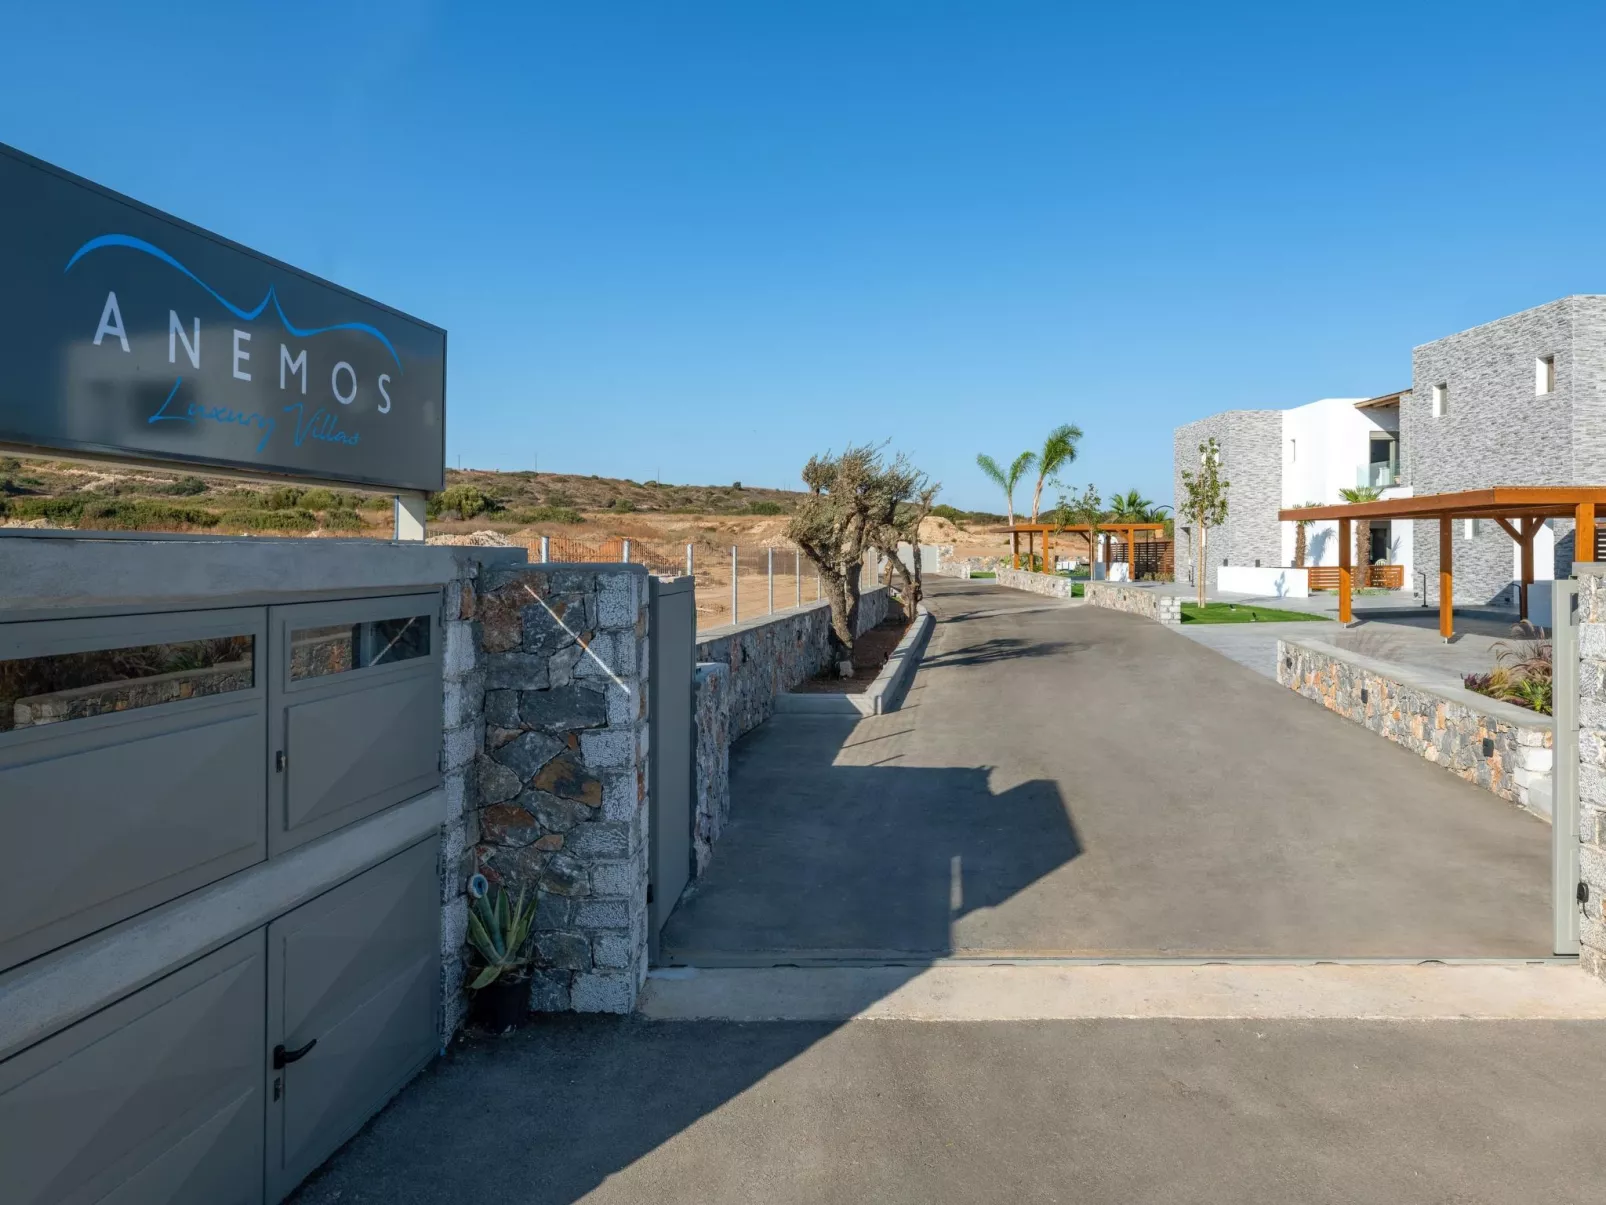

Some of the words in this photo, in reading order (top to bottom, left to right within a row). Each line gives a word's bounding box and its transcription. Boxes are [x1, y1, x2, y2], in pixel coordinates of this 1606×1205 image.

[93, 291, 391, 414] ANEMOS
[148, 376, 276, 453] Luxury
[283, 403, 361, 447] Villas
